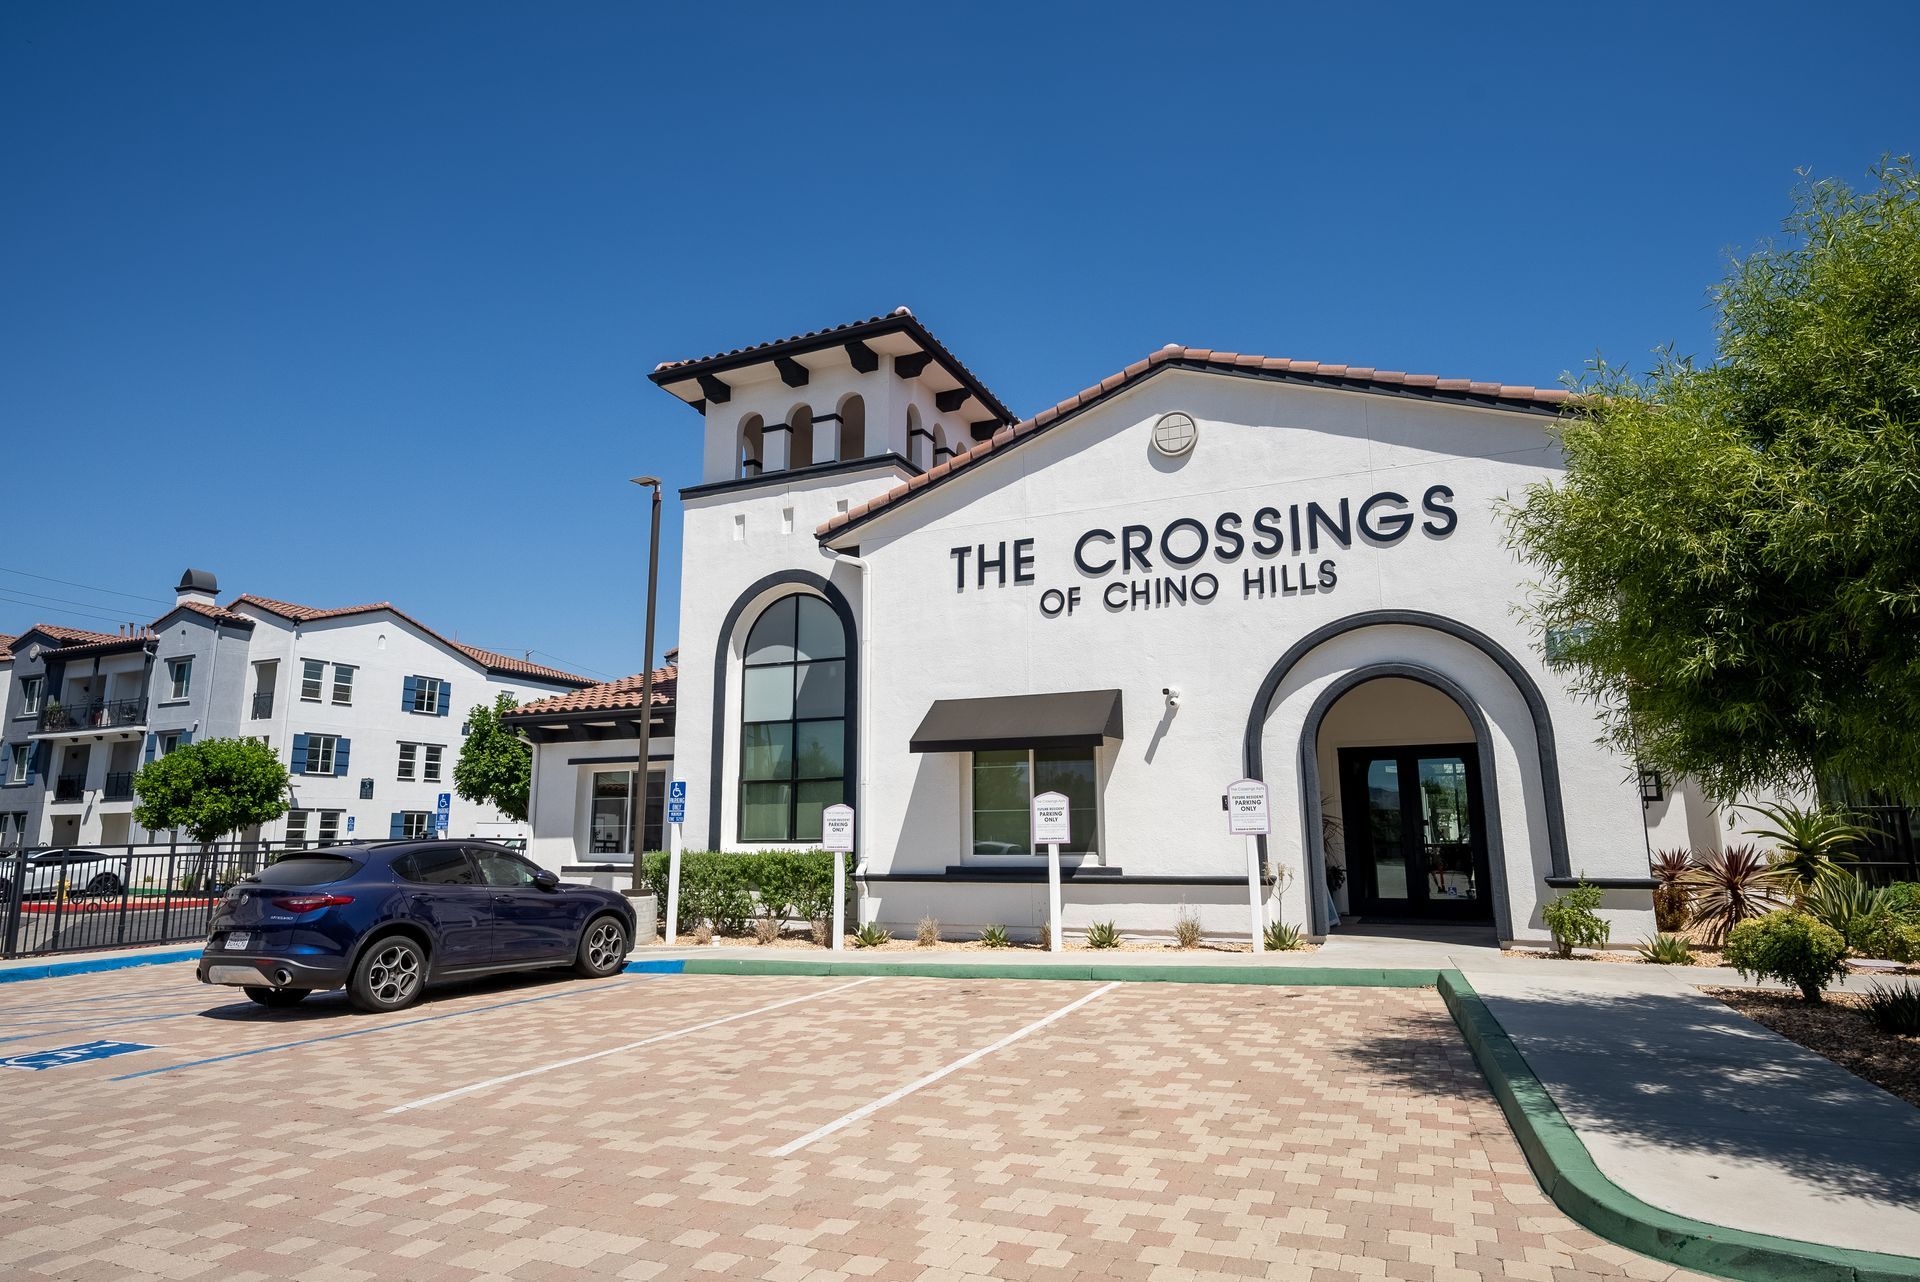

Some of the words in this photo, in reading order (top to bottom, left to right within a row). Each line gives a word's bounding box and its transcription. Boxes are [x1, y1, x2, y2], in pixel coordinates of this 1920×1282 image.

[950, 537, 1035, 589] THE
[1074, 484, 1458, 576] CROSSINGS
[1040, 587, 1081, 615] OF
[1103, 572, 1219, 609] CHINO
[1244, 559, 1338, 597] HILLS
